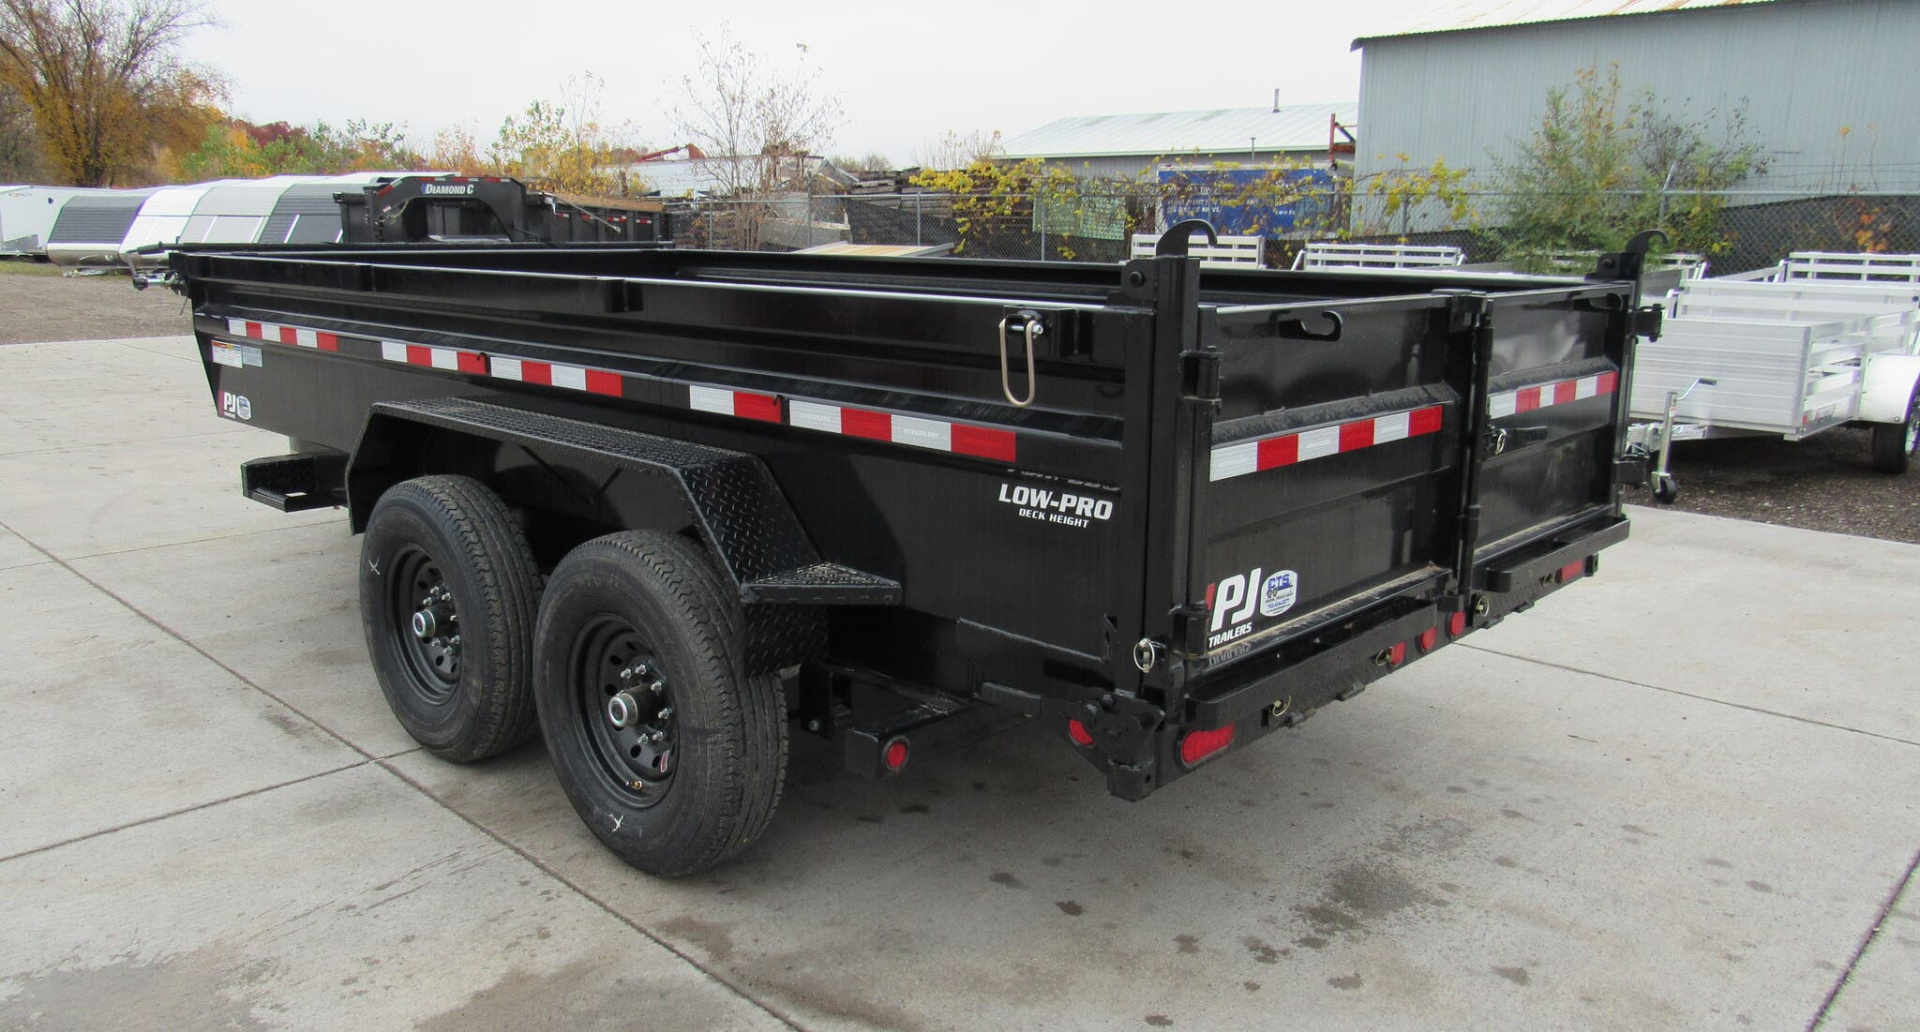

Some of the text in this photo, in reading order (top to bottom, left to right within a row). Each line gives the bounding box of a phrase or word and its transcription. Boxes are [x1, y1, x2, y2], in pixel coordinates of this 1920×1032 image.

[426, 183, 474, 194] DIAMOND C
[224, 392, 236, 412] PJ
[998, 483, 1114, 521] LOW-PRO
[1018, 508, 1090, 529] DECK HEIGHT
[1267, 573, 1291, 590] CTS
[1210, 567, 1262, 633] PJ
[1208, 621, 1253, 649] TRAILERS
